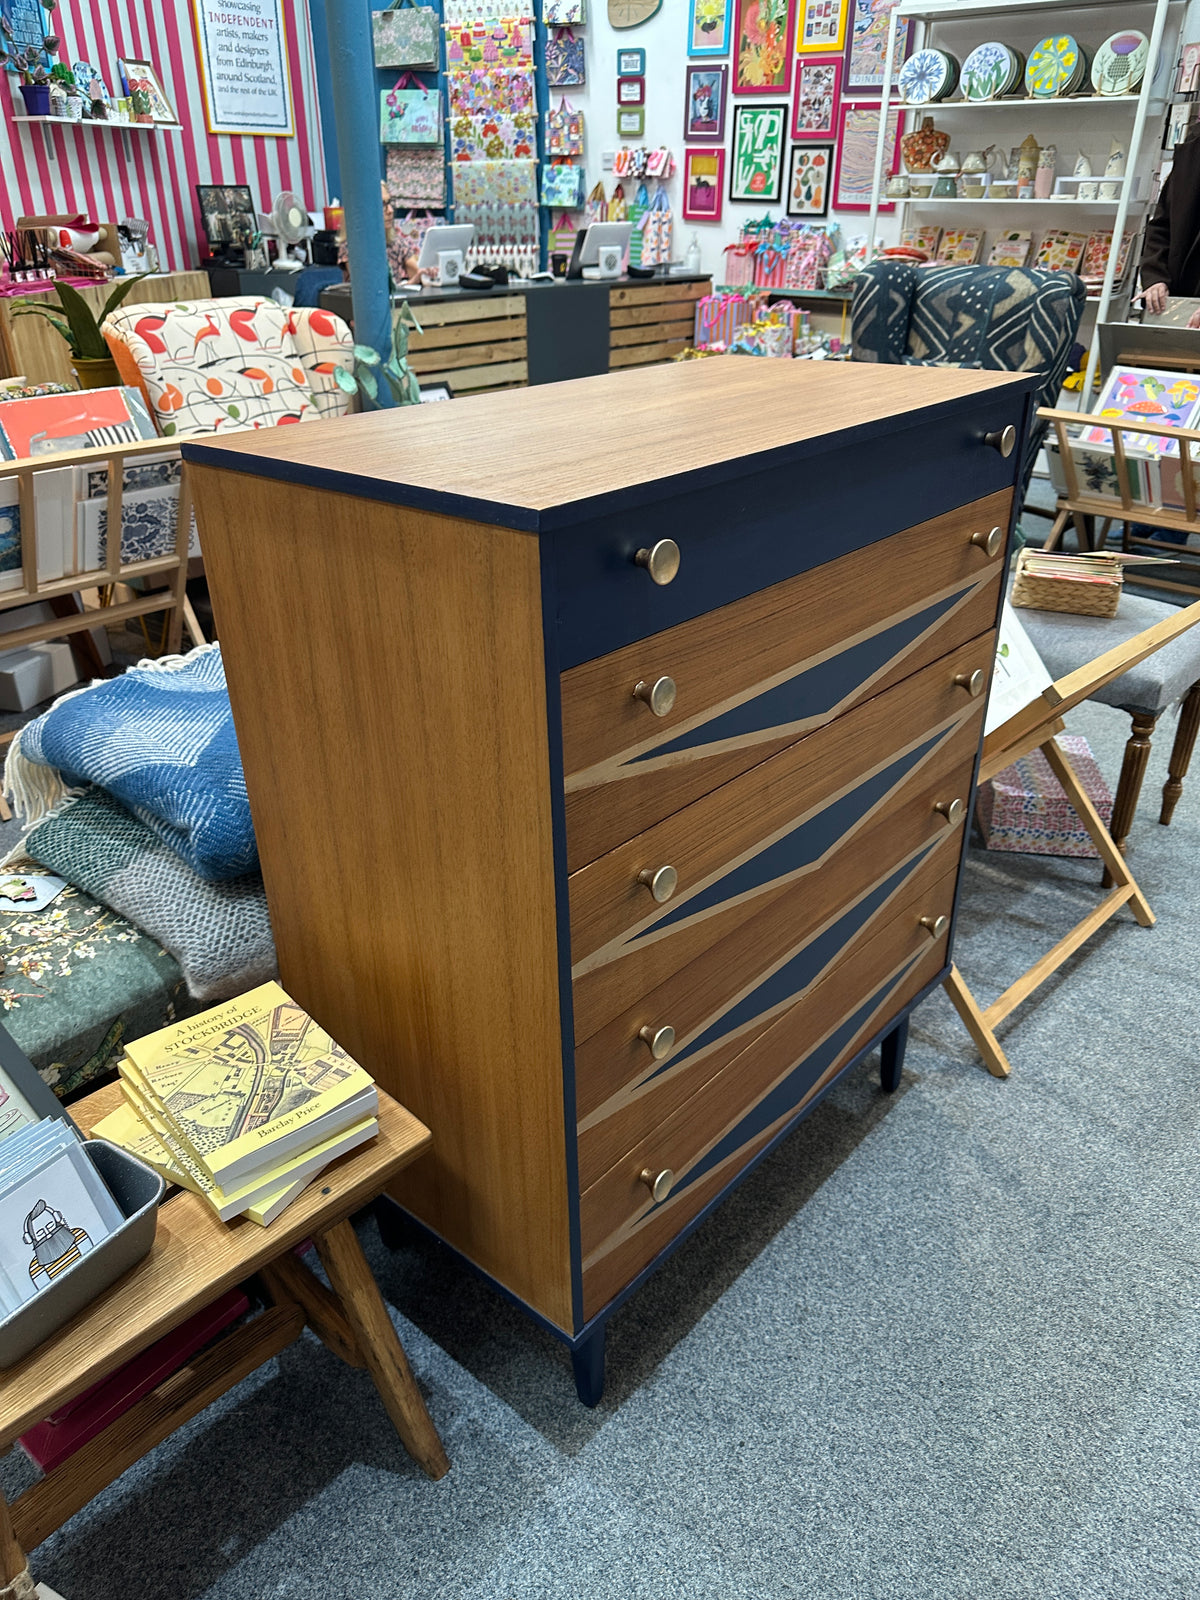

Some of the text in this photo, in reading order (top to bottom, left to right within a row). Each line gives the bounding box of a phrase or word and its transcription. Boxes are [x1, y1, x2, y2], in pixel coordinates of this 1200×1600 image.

[208, 11, 274, 29] INDEPENDENT
[216, 28, 269, 42] artists, makers
[218, 42, 270, 57] and designers
[216, 54, 275, 72] from Edinburgh,
[216, 72, 278, 85] around Scotland,
[850, 74, 900, 83] EDINBUG
[218, 85, 230, 93] and
[230, 86, 239, 94] the
[251, 87, 258, 95] of
[258, 88, 267, 96] the
[175, 1004, 239, 1037] A history of
[164, 1005, 263, 1053] STOCKBRIDGE
[257, 1102, 321, 1138] Barclay Price
